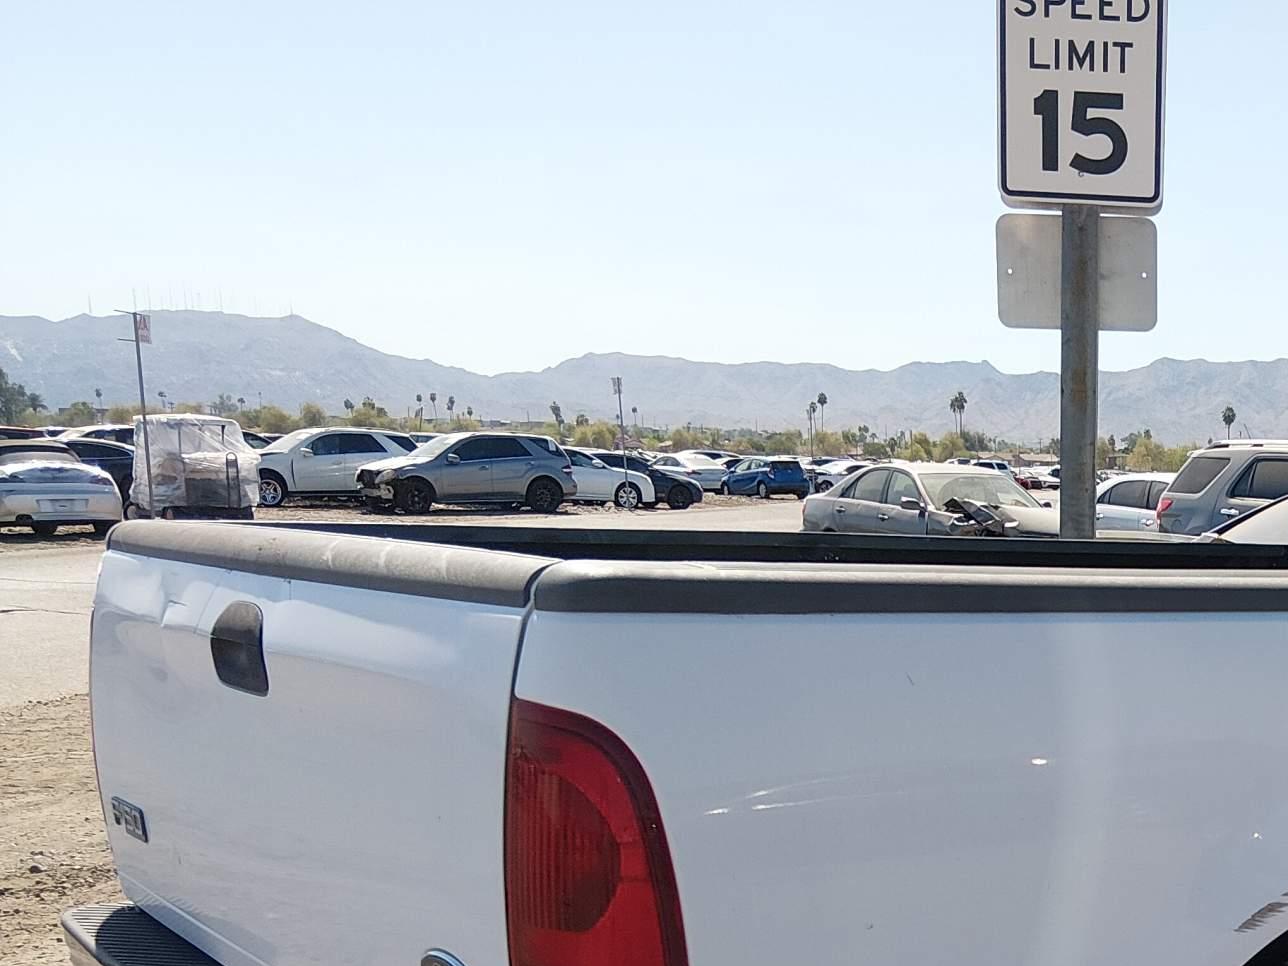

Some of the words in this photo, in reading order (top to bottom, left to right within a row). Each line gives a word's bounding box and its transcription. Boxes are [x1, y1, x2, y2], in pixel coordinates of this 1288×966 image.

[1014, 0, 1150, 22] SPEED
[1029, 37, 1134, 73] LIMIT
[1033, 89, 1128, 175] 15
